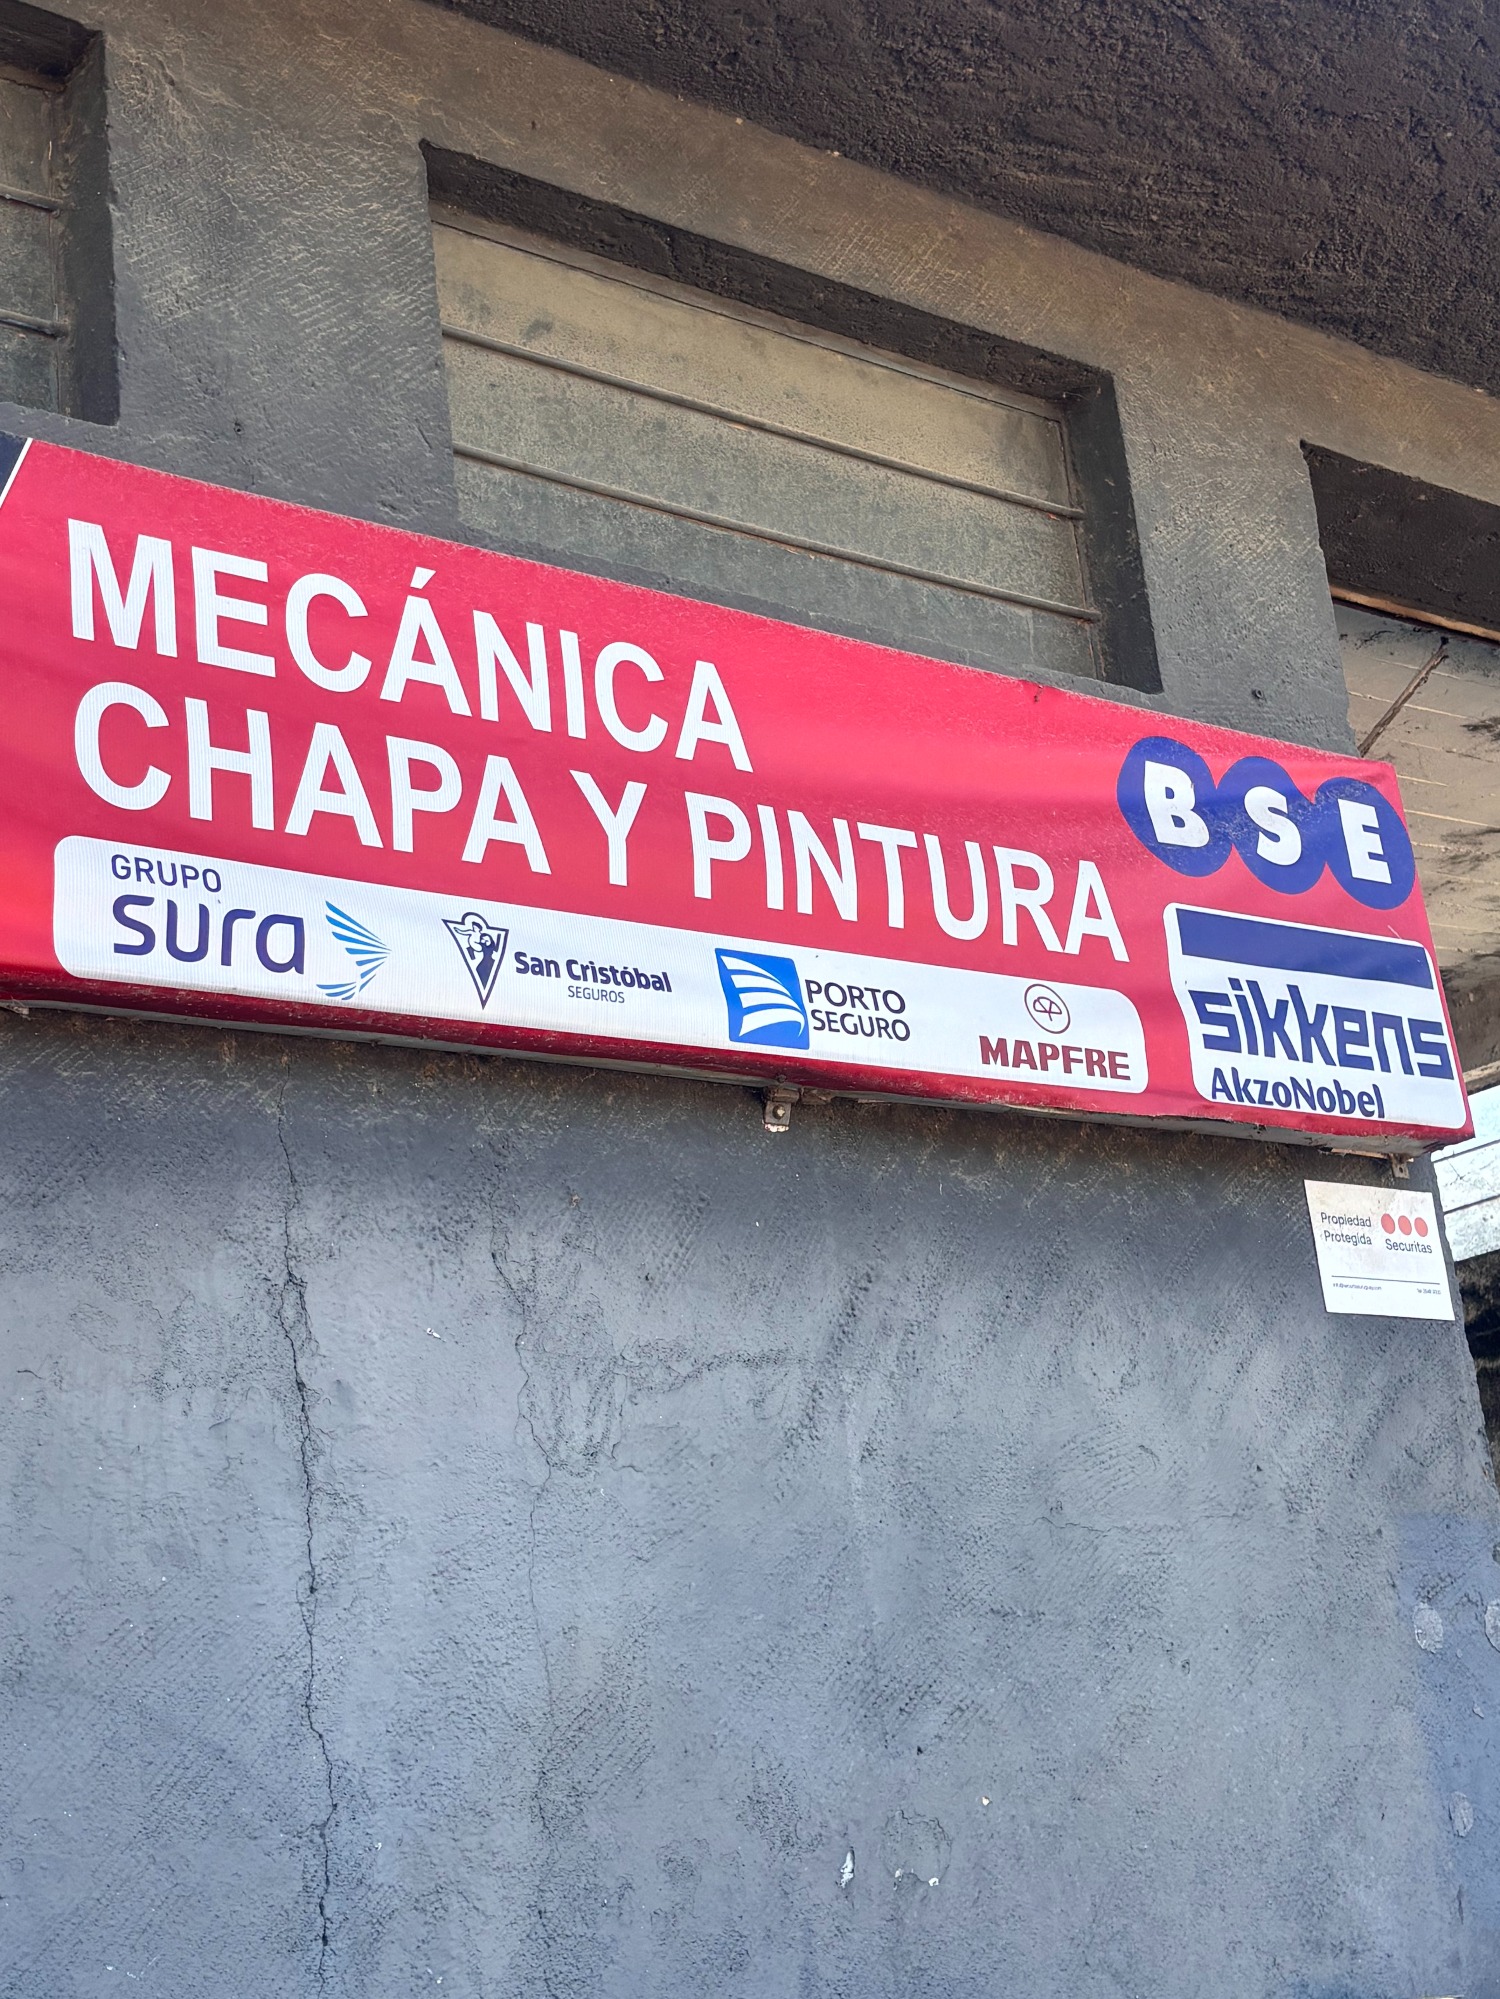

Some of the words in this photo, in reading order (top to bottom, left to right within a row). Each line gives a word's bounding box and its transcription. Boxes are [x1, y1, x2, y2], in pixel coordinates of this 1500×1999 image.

[68, 518, 754, 773] MECÁNICA
[74, 681, 551, 875] CHAPA
[569, 769, 648, 887] Y
[684, 790, 1130, 962] PINTURA
[1144, 760, 1393, 884] BSE
[111, 854, 222, 893] GRUPO
[113, 894, 305, 975] sura
[514, 951, 561, 979] San
[565, 959, 673, 993] Cristóbal
[567, 985, 626, 1004] SEGUROS
[805, 978, 906, 1015] PORTO
[810, 1009, 911, 1042] SEGURO
[1188, 977, 1454, 1081] sikkens
[979, 1035, 1131, 1081] MAPFRE
[1211, 1067, 1386, 1119] AkzoNobel
[1320, 1211, 1373, 1230] Propiedad
[1323, 1230, 1373, 1246] Protegida
[1385, 1238, 1433, 1254] Securitas
